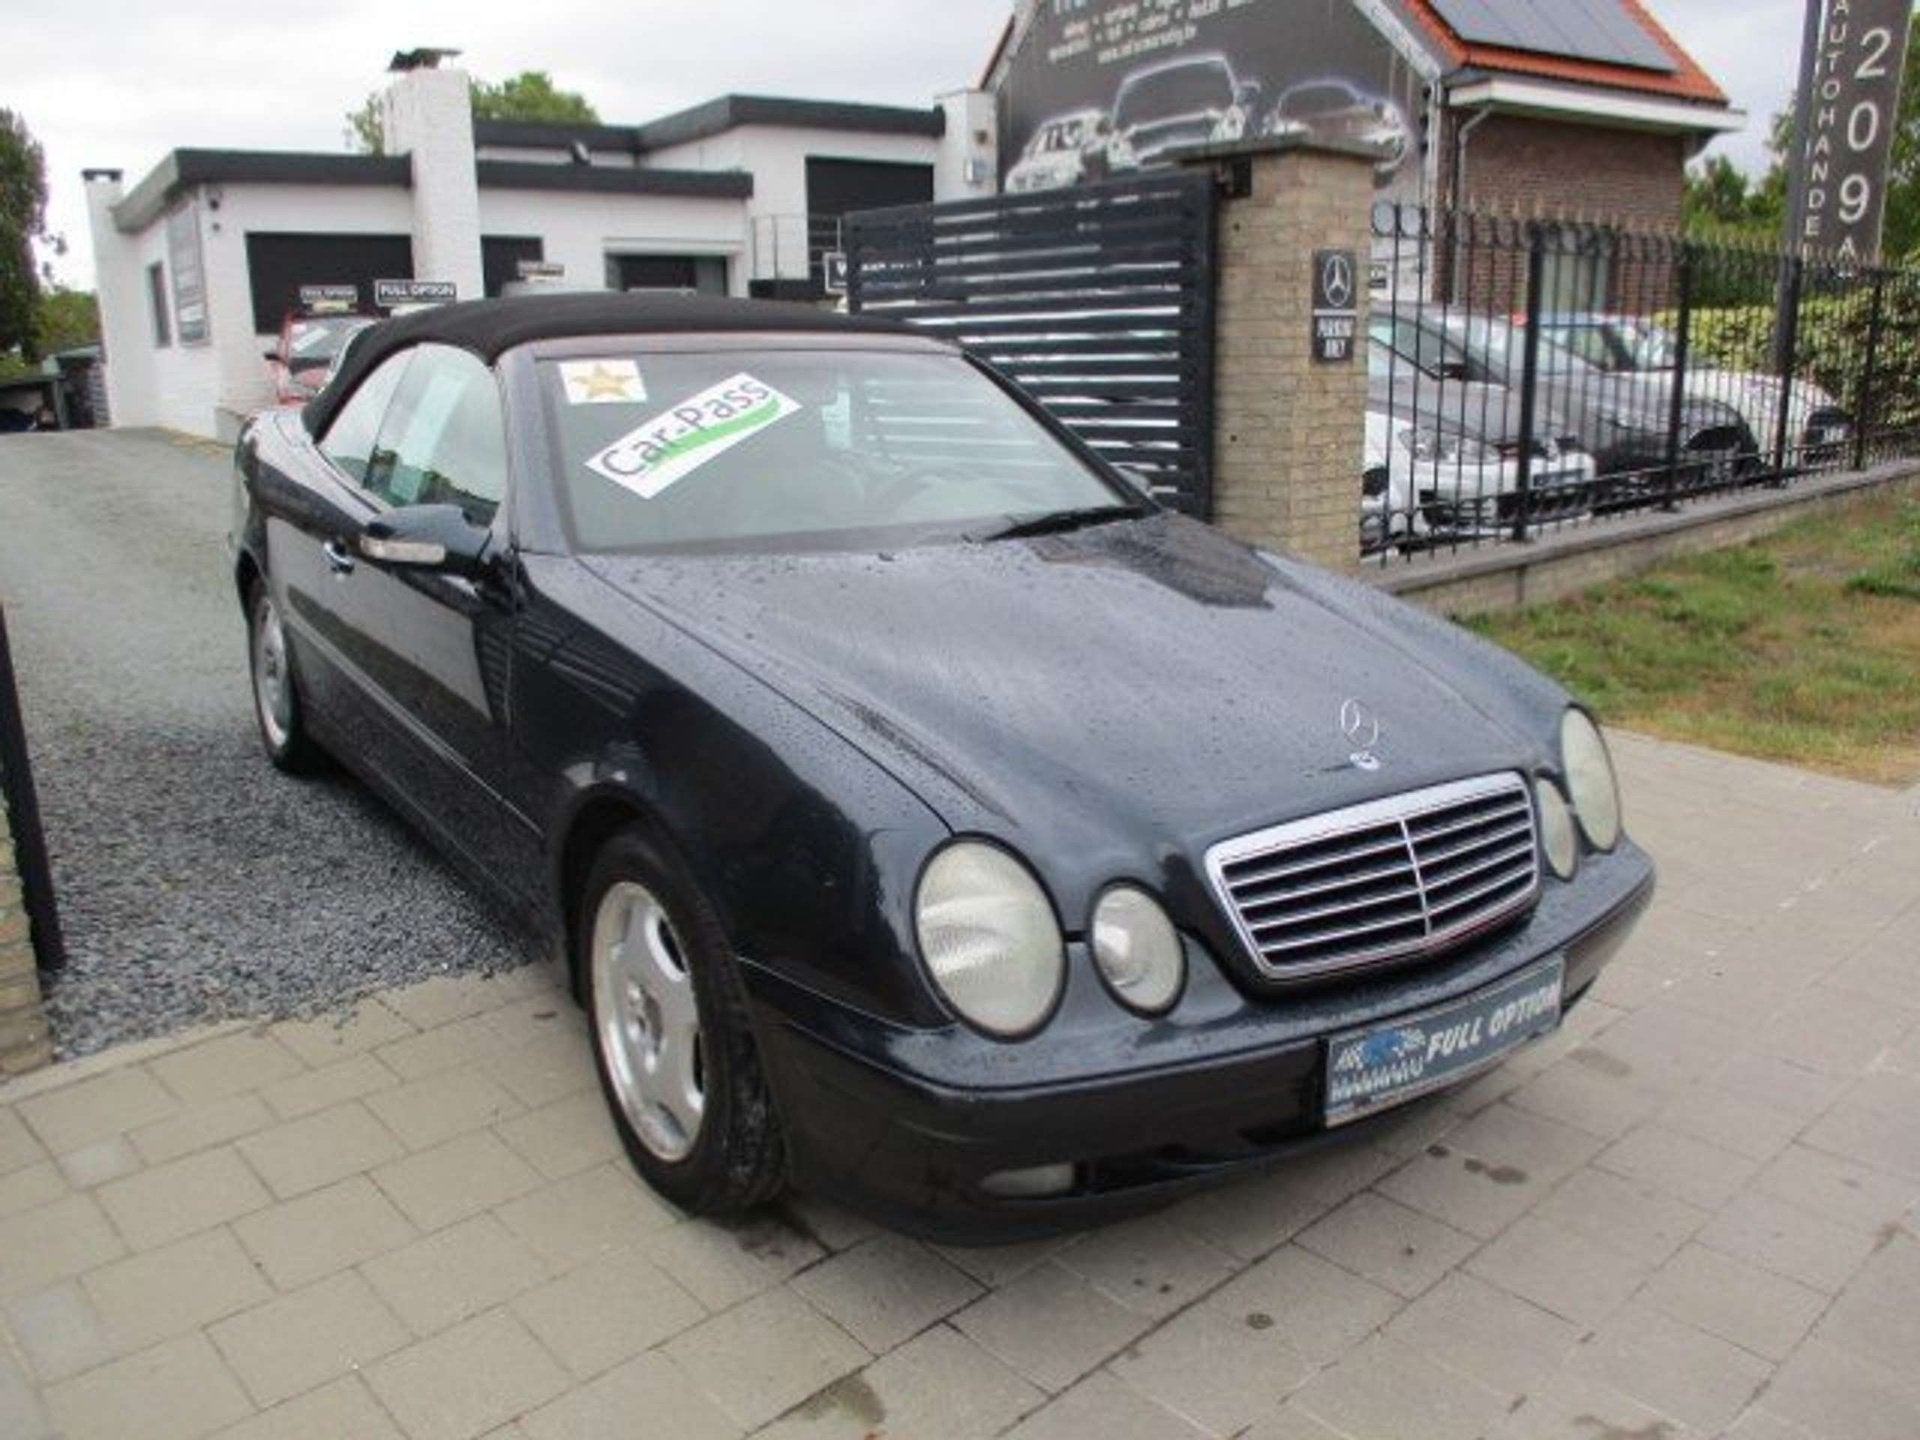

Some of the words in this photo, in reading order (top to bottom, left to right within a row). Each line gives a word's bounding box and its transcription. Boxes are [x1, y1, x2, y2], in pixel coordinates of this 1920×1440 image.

[380, 283, 409, 297] FULL
[411, 283, 456, 298] OPTION
[600, 381, 770, 477] Car-Pass
[1425, 1016, 1484, 1063] FULL
